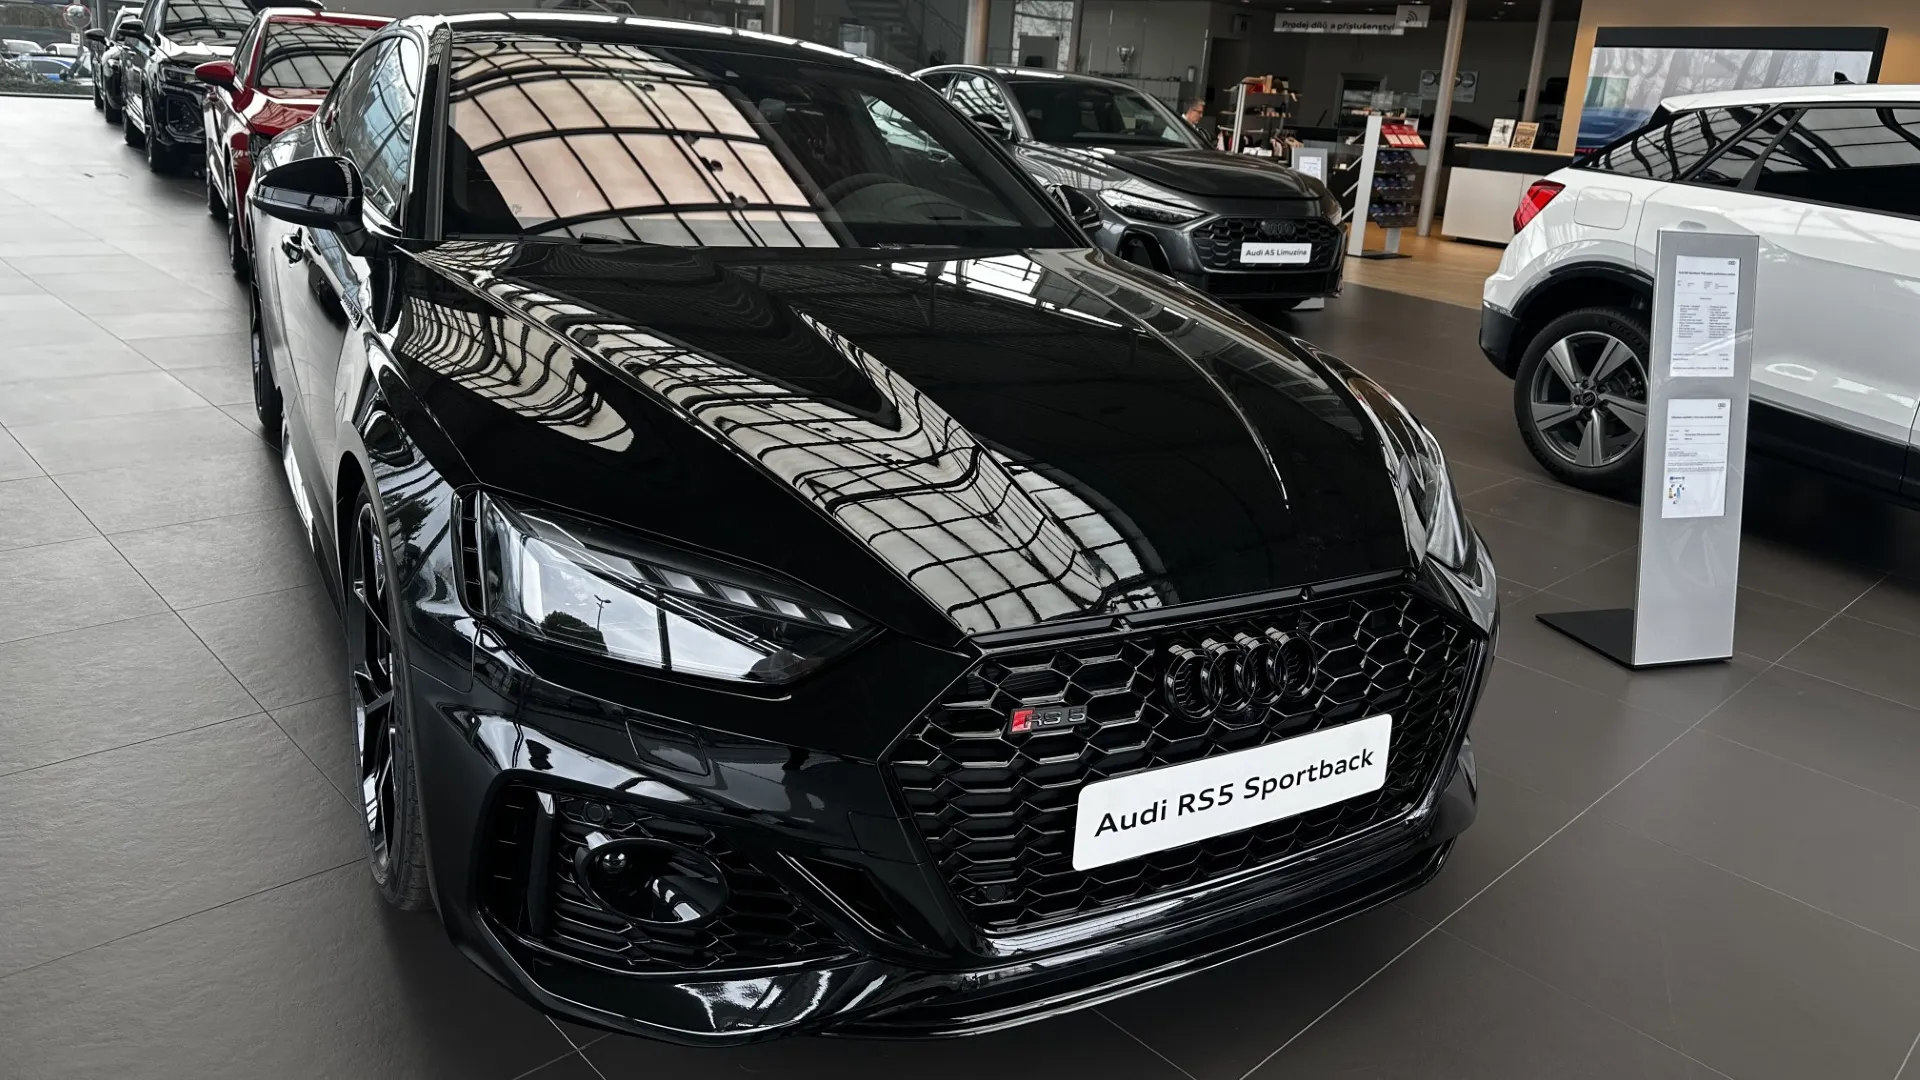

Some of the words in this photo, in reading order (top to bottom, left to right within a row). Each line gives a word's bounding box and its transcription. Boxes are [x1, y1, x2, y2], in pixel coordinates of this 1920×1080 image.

[1094, 799, 1167, 837] Audi
[1177, 782, 1234, 816] RS5
[1243, 748, 1374, 800] Sportback
